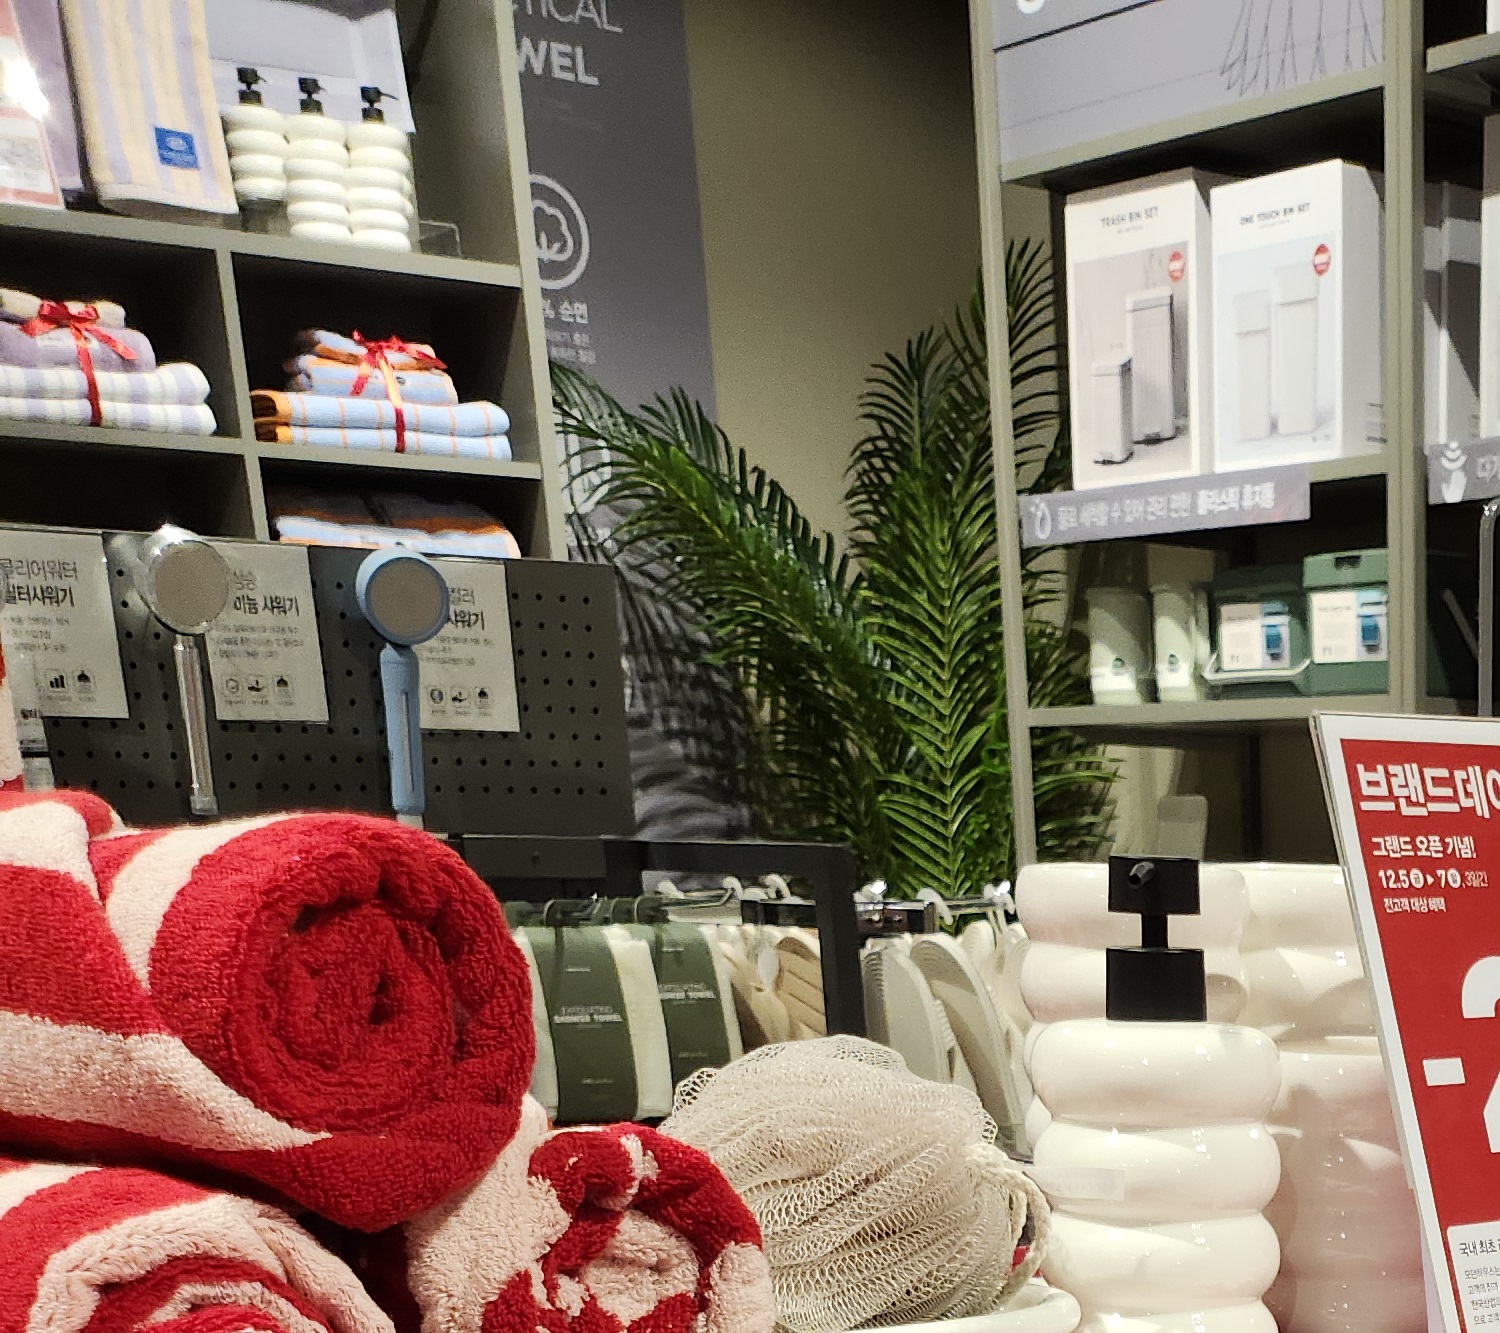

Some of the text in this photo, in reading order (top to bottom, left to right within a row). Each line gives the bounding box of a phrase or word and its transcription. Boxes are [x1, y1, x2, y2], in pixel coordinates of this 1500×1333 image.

[1242, 482, 1276, 510] 휴지통
[1372, 835, 1477, 859] 그랜드 오픈 기념!
[1411, 897, 1428, 913] 대상
[1459, 1240, 1479, 1257] 국내
[1479, 1239, 1497, 1255] 최초
